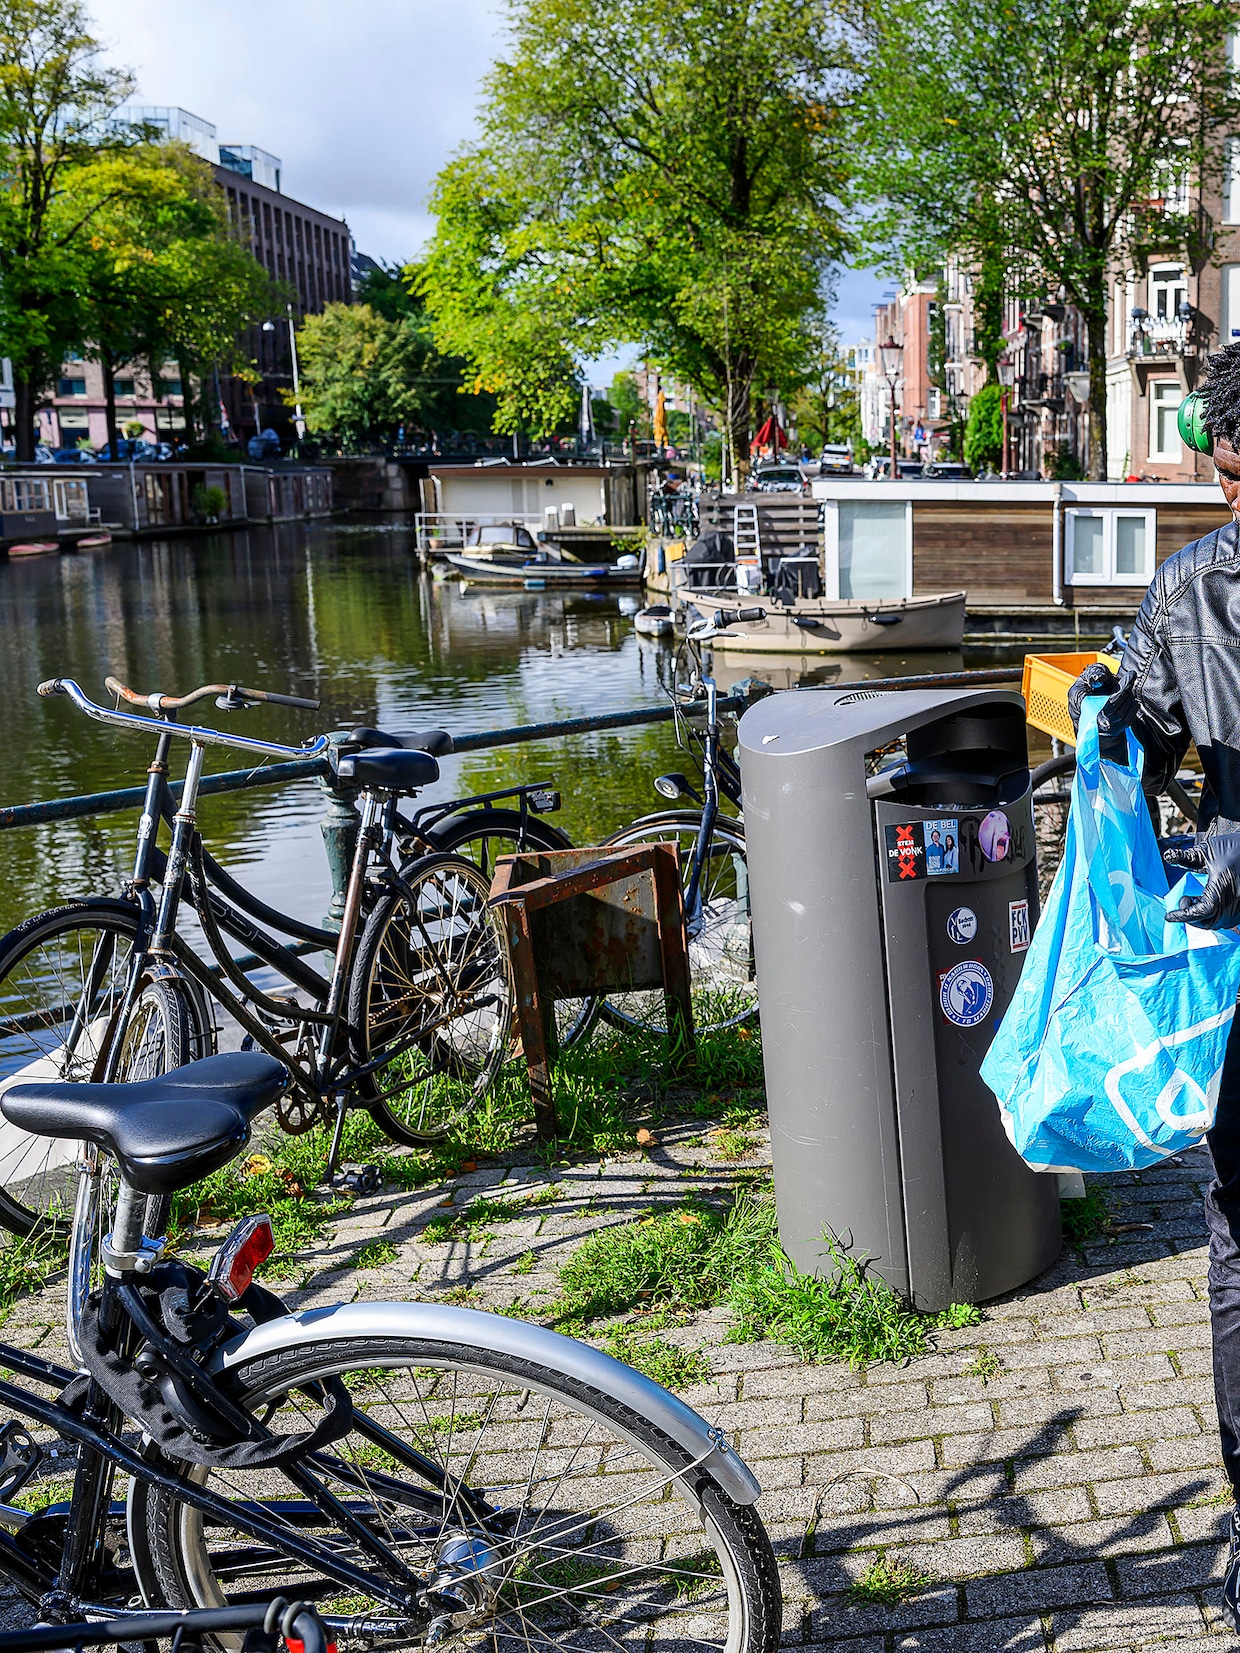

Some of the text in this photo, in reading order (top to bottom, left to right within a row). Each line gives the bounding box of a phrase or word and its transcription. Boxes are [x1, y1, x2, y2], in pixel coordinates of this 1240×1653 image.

[926, 820, 957, 830] DE BEL
[888, 846, 923, 858] DE VONK
[1011, 908, 1027, 927] FCK
[1012, 924, 1028, 944] PVV
